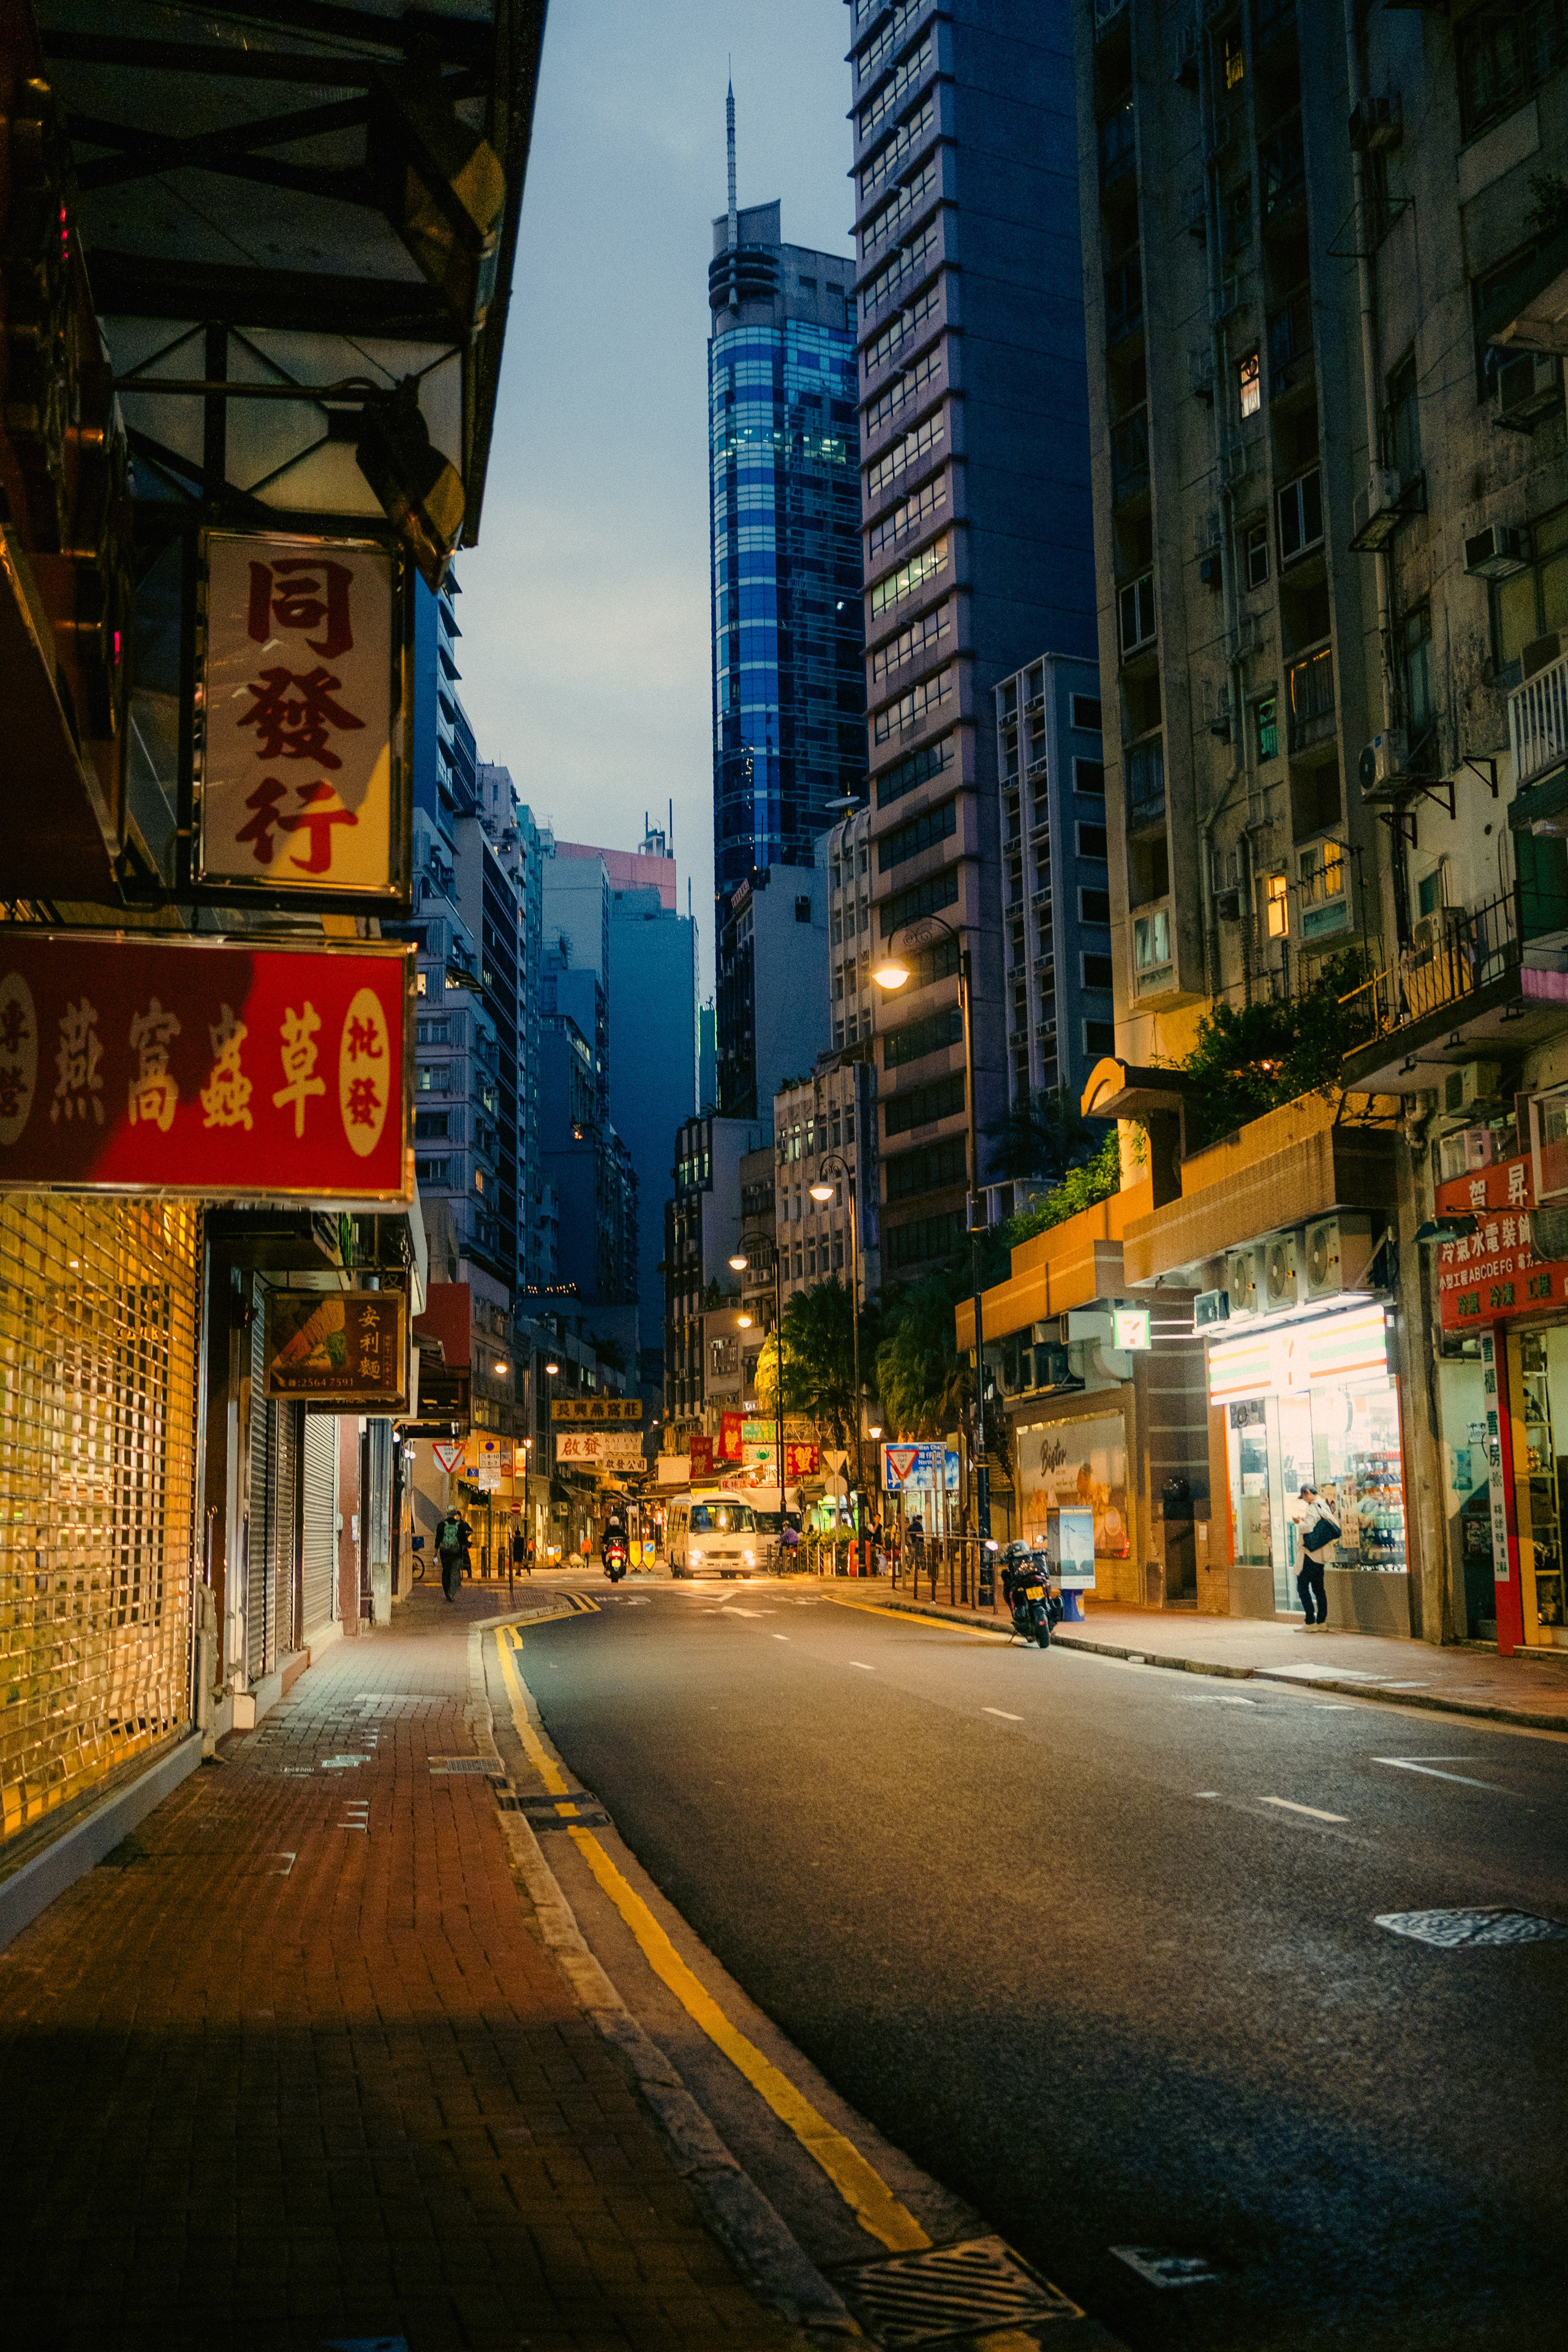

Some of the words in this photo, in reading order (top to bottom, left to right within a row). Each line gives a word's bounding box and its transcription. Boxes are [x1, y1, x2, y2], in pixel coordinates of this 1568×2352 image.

[236, 558, 366, 874] 同發行
[50, 995, 326, 1139] 燕窩蟲草
[347, 1016, 382, 1129] 批發
